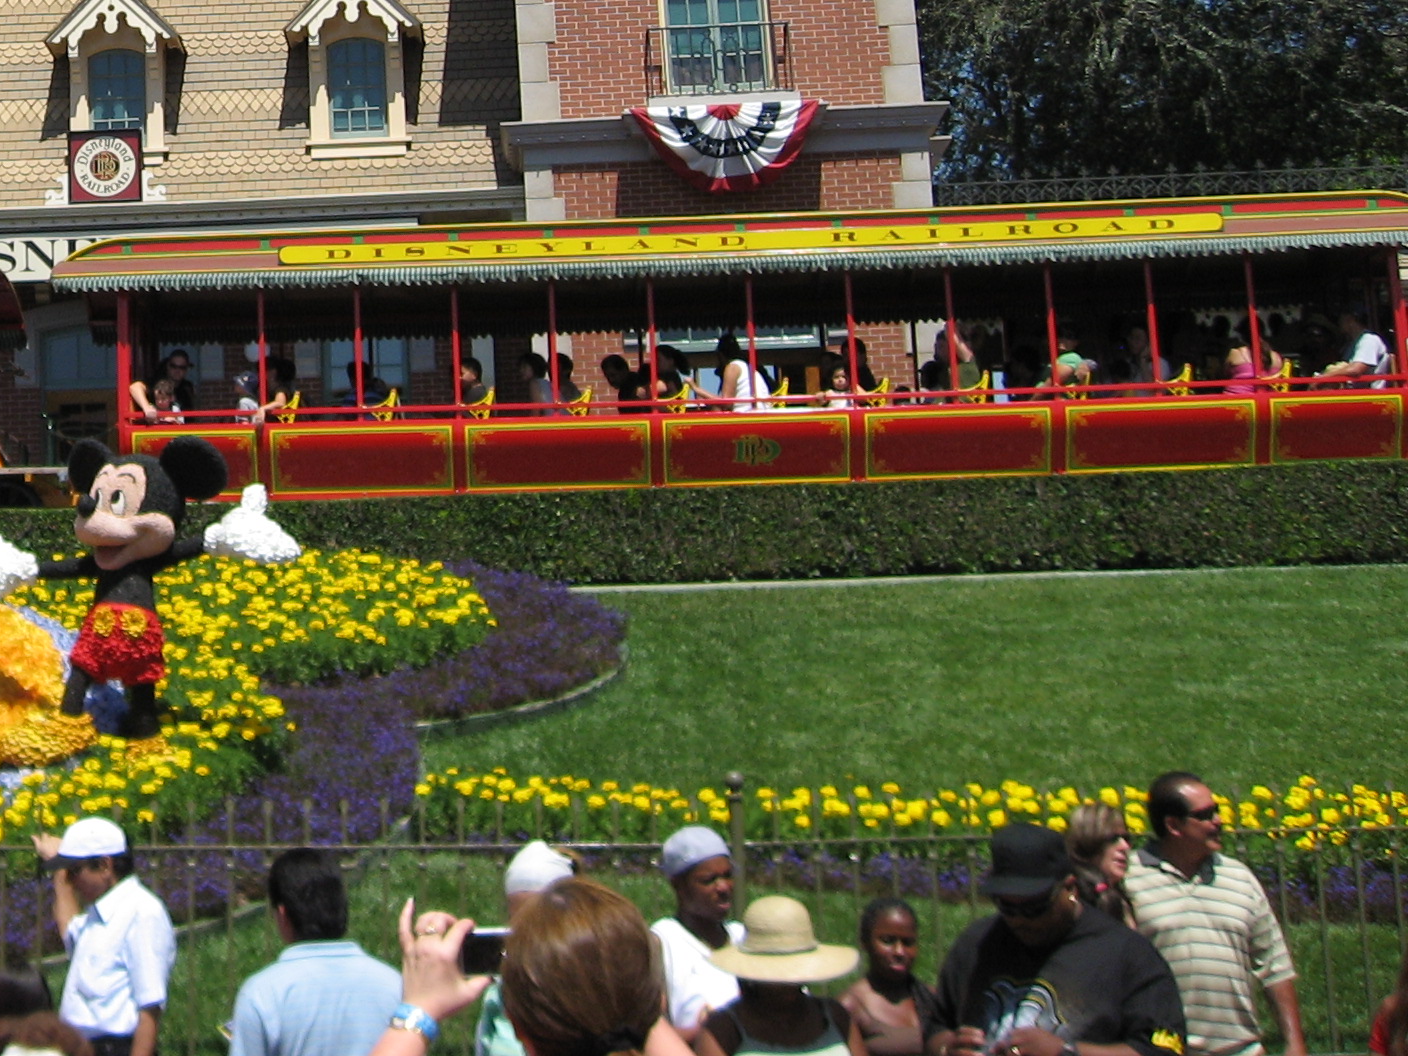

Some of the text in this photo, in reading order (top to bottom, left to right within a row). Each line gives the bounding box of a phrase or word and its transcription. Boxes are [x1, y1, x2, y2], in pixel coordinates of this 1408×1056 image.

[77, 138, 134, 165] Disneyland
[80, 172, 130, 194] RAILROAD
[326, 219, 1175, 260] DISNEYLAND RAILROAD
